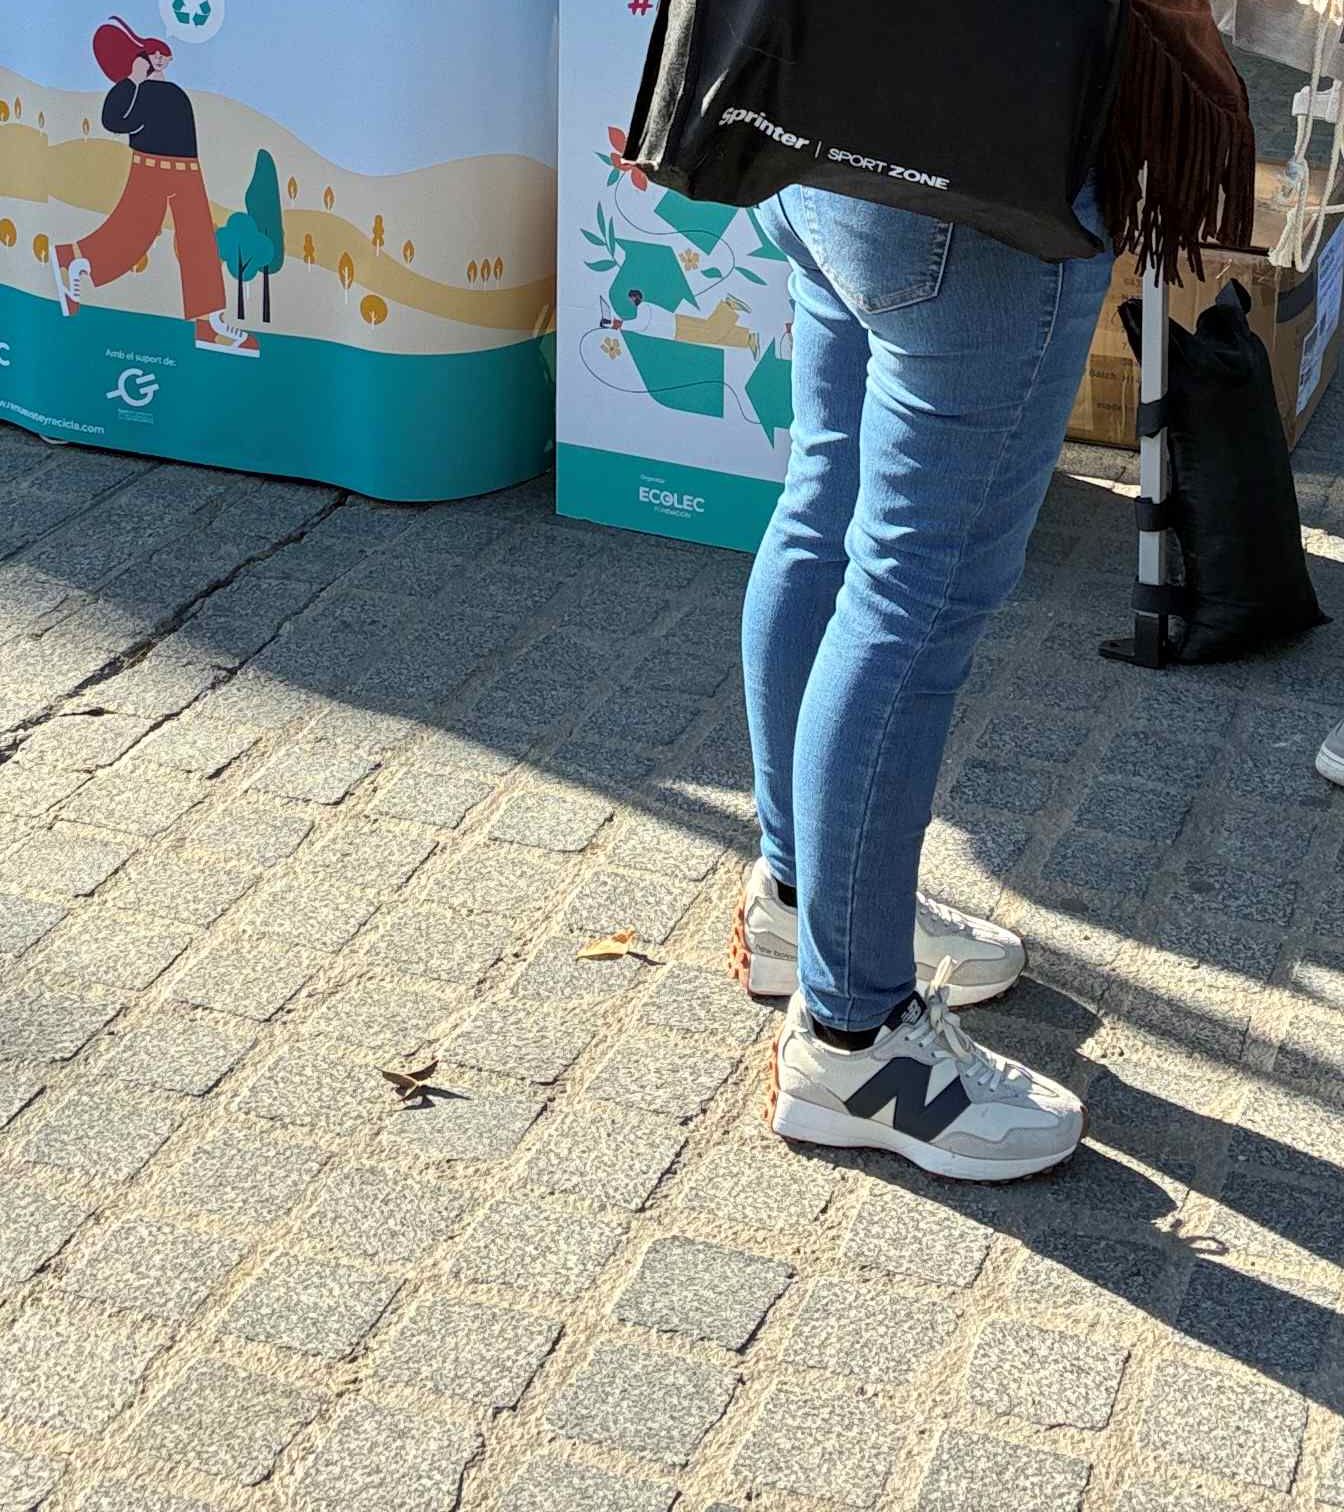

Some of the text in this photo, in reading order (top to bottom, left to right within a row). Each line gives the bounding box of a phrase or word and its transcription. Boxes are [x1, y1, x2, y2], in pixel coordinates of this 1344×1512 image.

[718, 106, 950, 190] sprinter SPORT ZONE
[640, 486, 704, 512] ECOLEC
